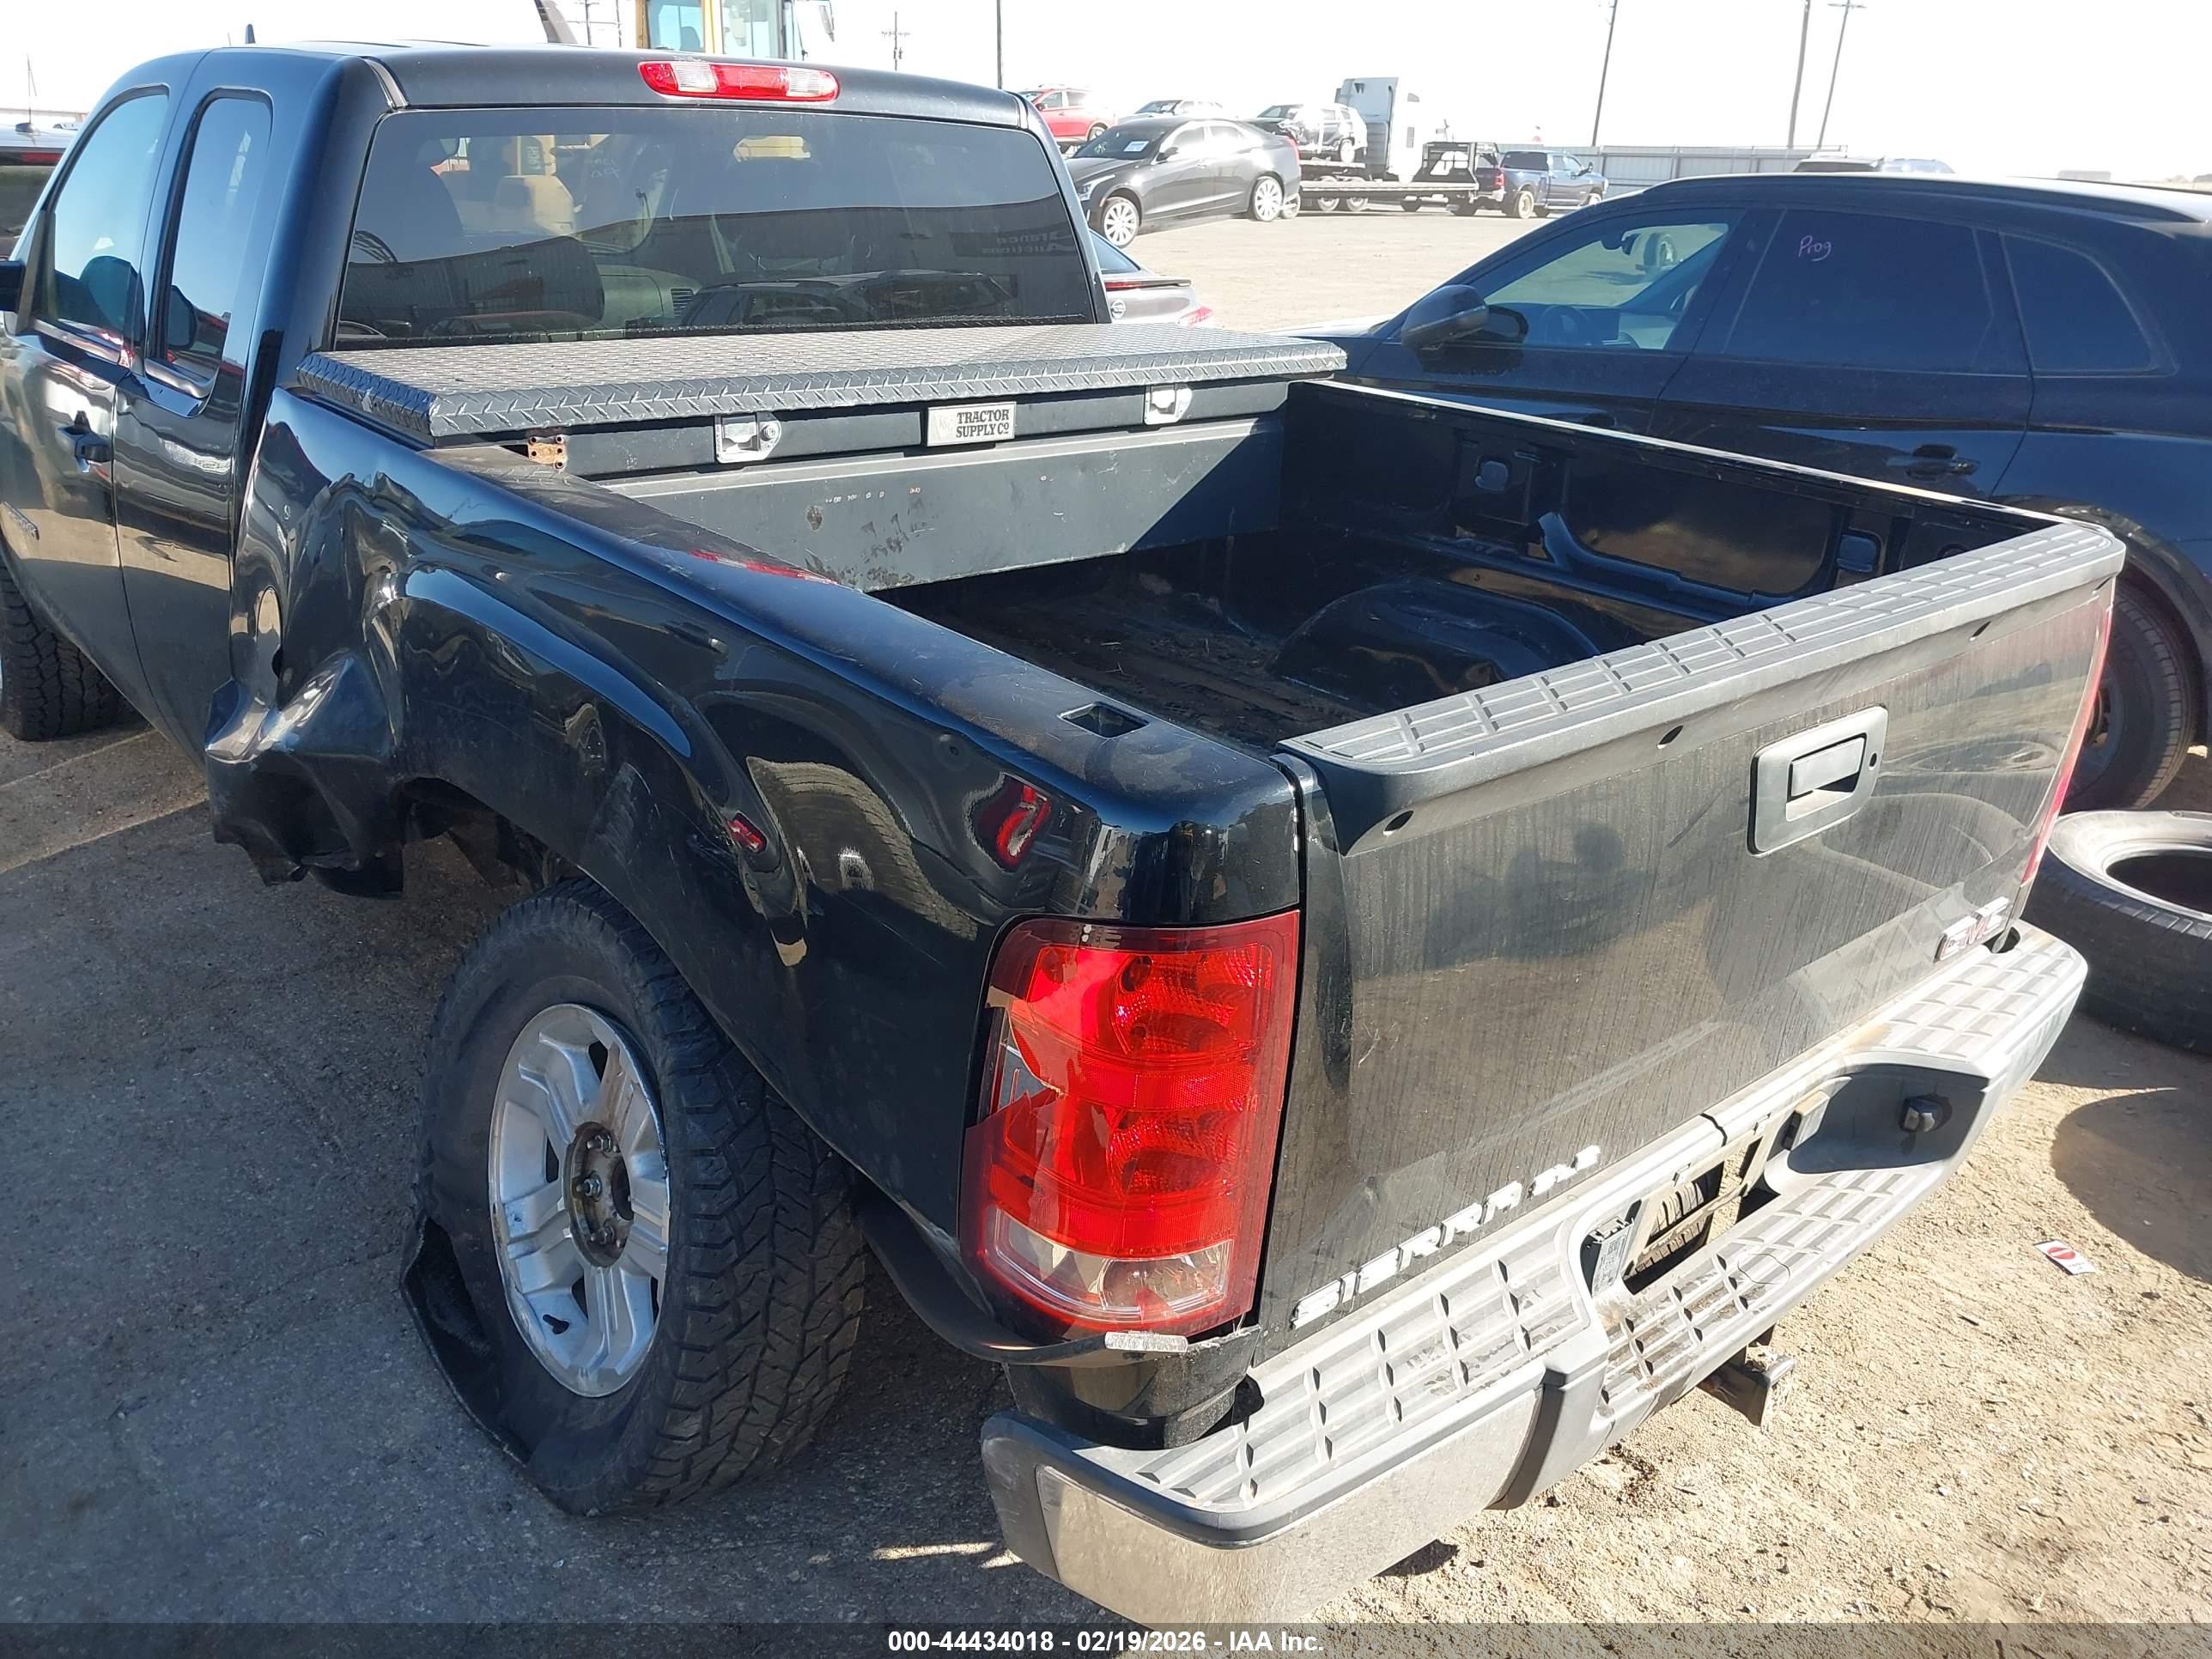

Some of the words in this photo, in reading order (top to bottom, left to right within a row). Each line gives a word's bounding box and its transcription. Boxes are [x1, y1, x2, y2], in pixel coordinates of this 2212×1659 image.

[1798, 234, 1832, 261] Prog
[957, 409, 1010, 424] TRACTOR
[956, 423, 996, 438] SUPPLY
[1933, 896, 2009, 963] GMC
